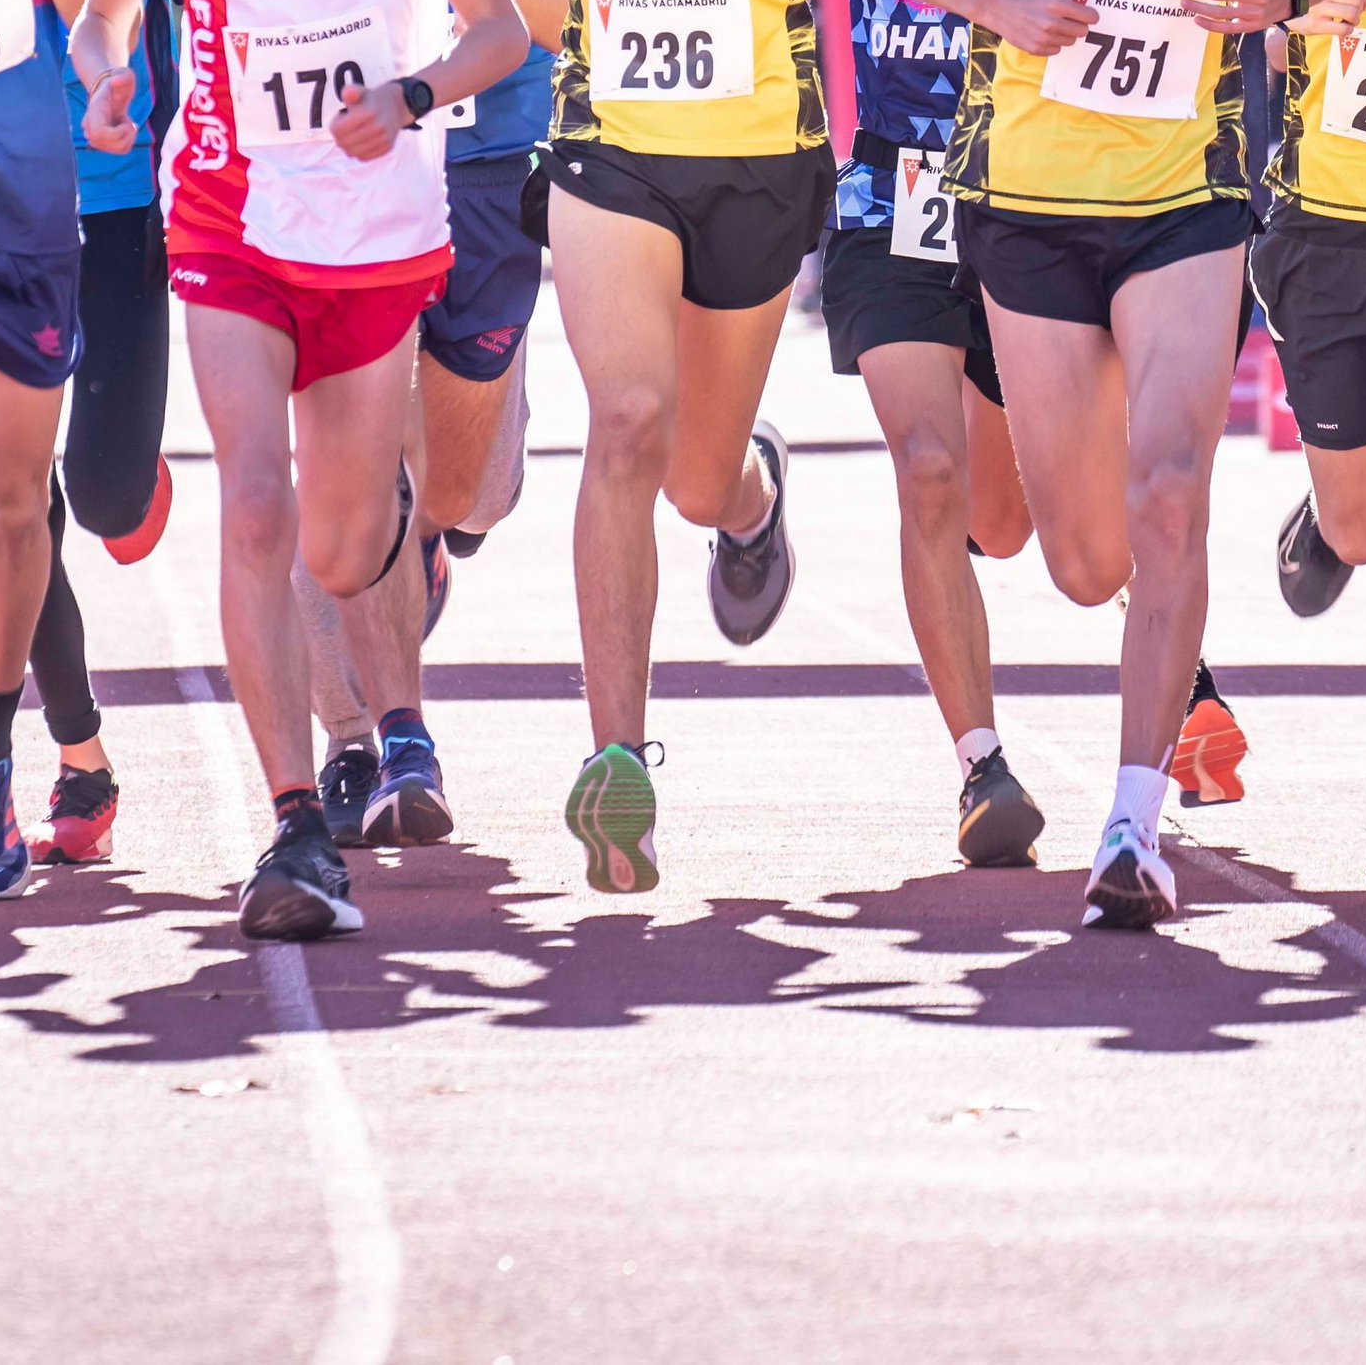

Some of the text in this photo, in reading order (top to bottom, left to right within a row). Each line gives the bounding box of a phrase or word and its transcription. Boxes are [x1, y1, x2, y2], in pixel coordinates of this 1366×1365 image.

[255, 17, 372, 48] RIVAS VACIAMADRID
[620, 30, 714, 90] 236
[1079, 30, 1170, 98] 751
[919, 196, 955, 251] 2
